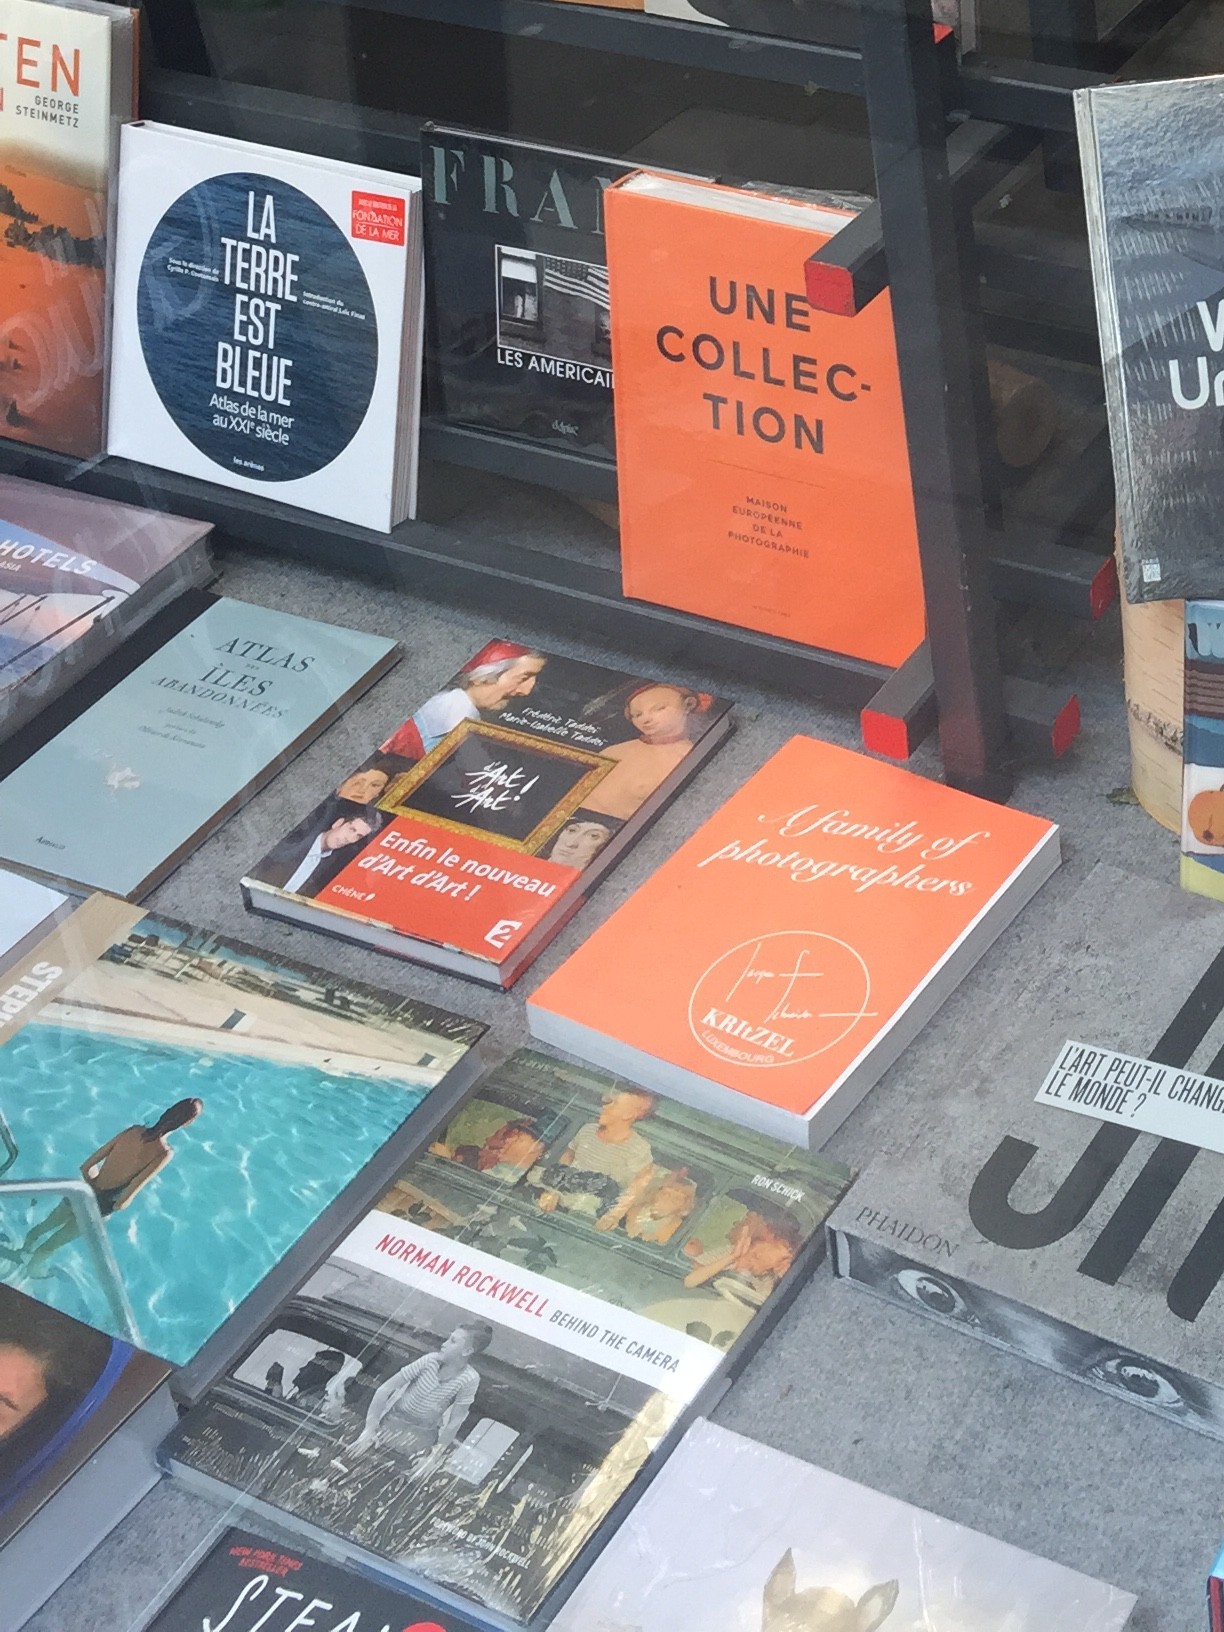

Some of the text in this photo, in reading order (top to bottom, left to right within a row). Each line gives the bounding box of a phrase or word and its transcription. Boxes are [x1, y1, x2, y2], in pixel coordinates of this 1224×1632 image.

[16, 105, 79, 128] STEINMETZ
[35, 95, 79, 114] GEORGE
[247, 191, 276, 243] LA
[353, 209, 403, 226] FONDATION
[355, 223, 399, 240] DE LA MER
[221, 237, 299, 302] TERRE
[233, 293, 281, 349] EST
[709, 276, 811, 332] UNE
[216, 341, 292, 407] BLEUE
[497, 348, 523, 368] LES
[656, 325, 871, 402] COLLEC-
[209, 393, 295, 428] Atlas de la mer
[703, 392, 824, 454] TION
[212, 414, 289, 445] au XXIe siècle
[732, 505, 802, 530] EUROPÉENNE
[746, 496, 787, 513] MAISON
[728, 531, 809, 558] PHOTOGRAPHIE
[752, 524, 783, 538] DE LA
[0, 539, 98, 575] HOTELS
[215, 637, 316, 673] ATLAS
[152, 677, 288, 719] ABANDONNÉES
[522, 707, 562, 724] Frédéric
[757, 804, 991, 860] A family of
[358, 853, 468, 898] d'Art d'Art
[380, 830, 556, 897] Enfin le nouveau
[697, 837, 978, 896] photographers
[331, 884, 366, 901] CHÊNE
[701, 1030, 774, 1064] LUXEMBOURG
[1058, 1044, 1107, 1079] L'ART
[1103, 1057, 1169, 1092] PEUT-IL
[1045, 1072, 1134, 1115] LE MONDE
[751, 1174, 806, 1202] RON SCHICK
[855, 1206, 959, 1259] PHAIDON
[375, 1233, 681, 1373] NORMAN ROCKWELL BEHIND THE CAMERA
